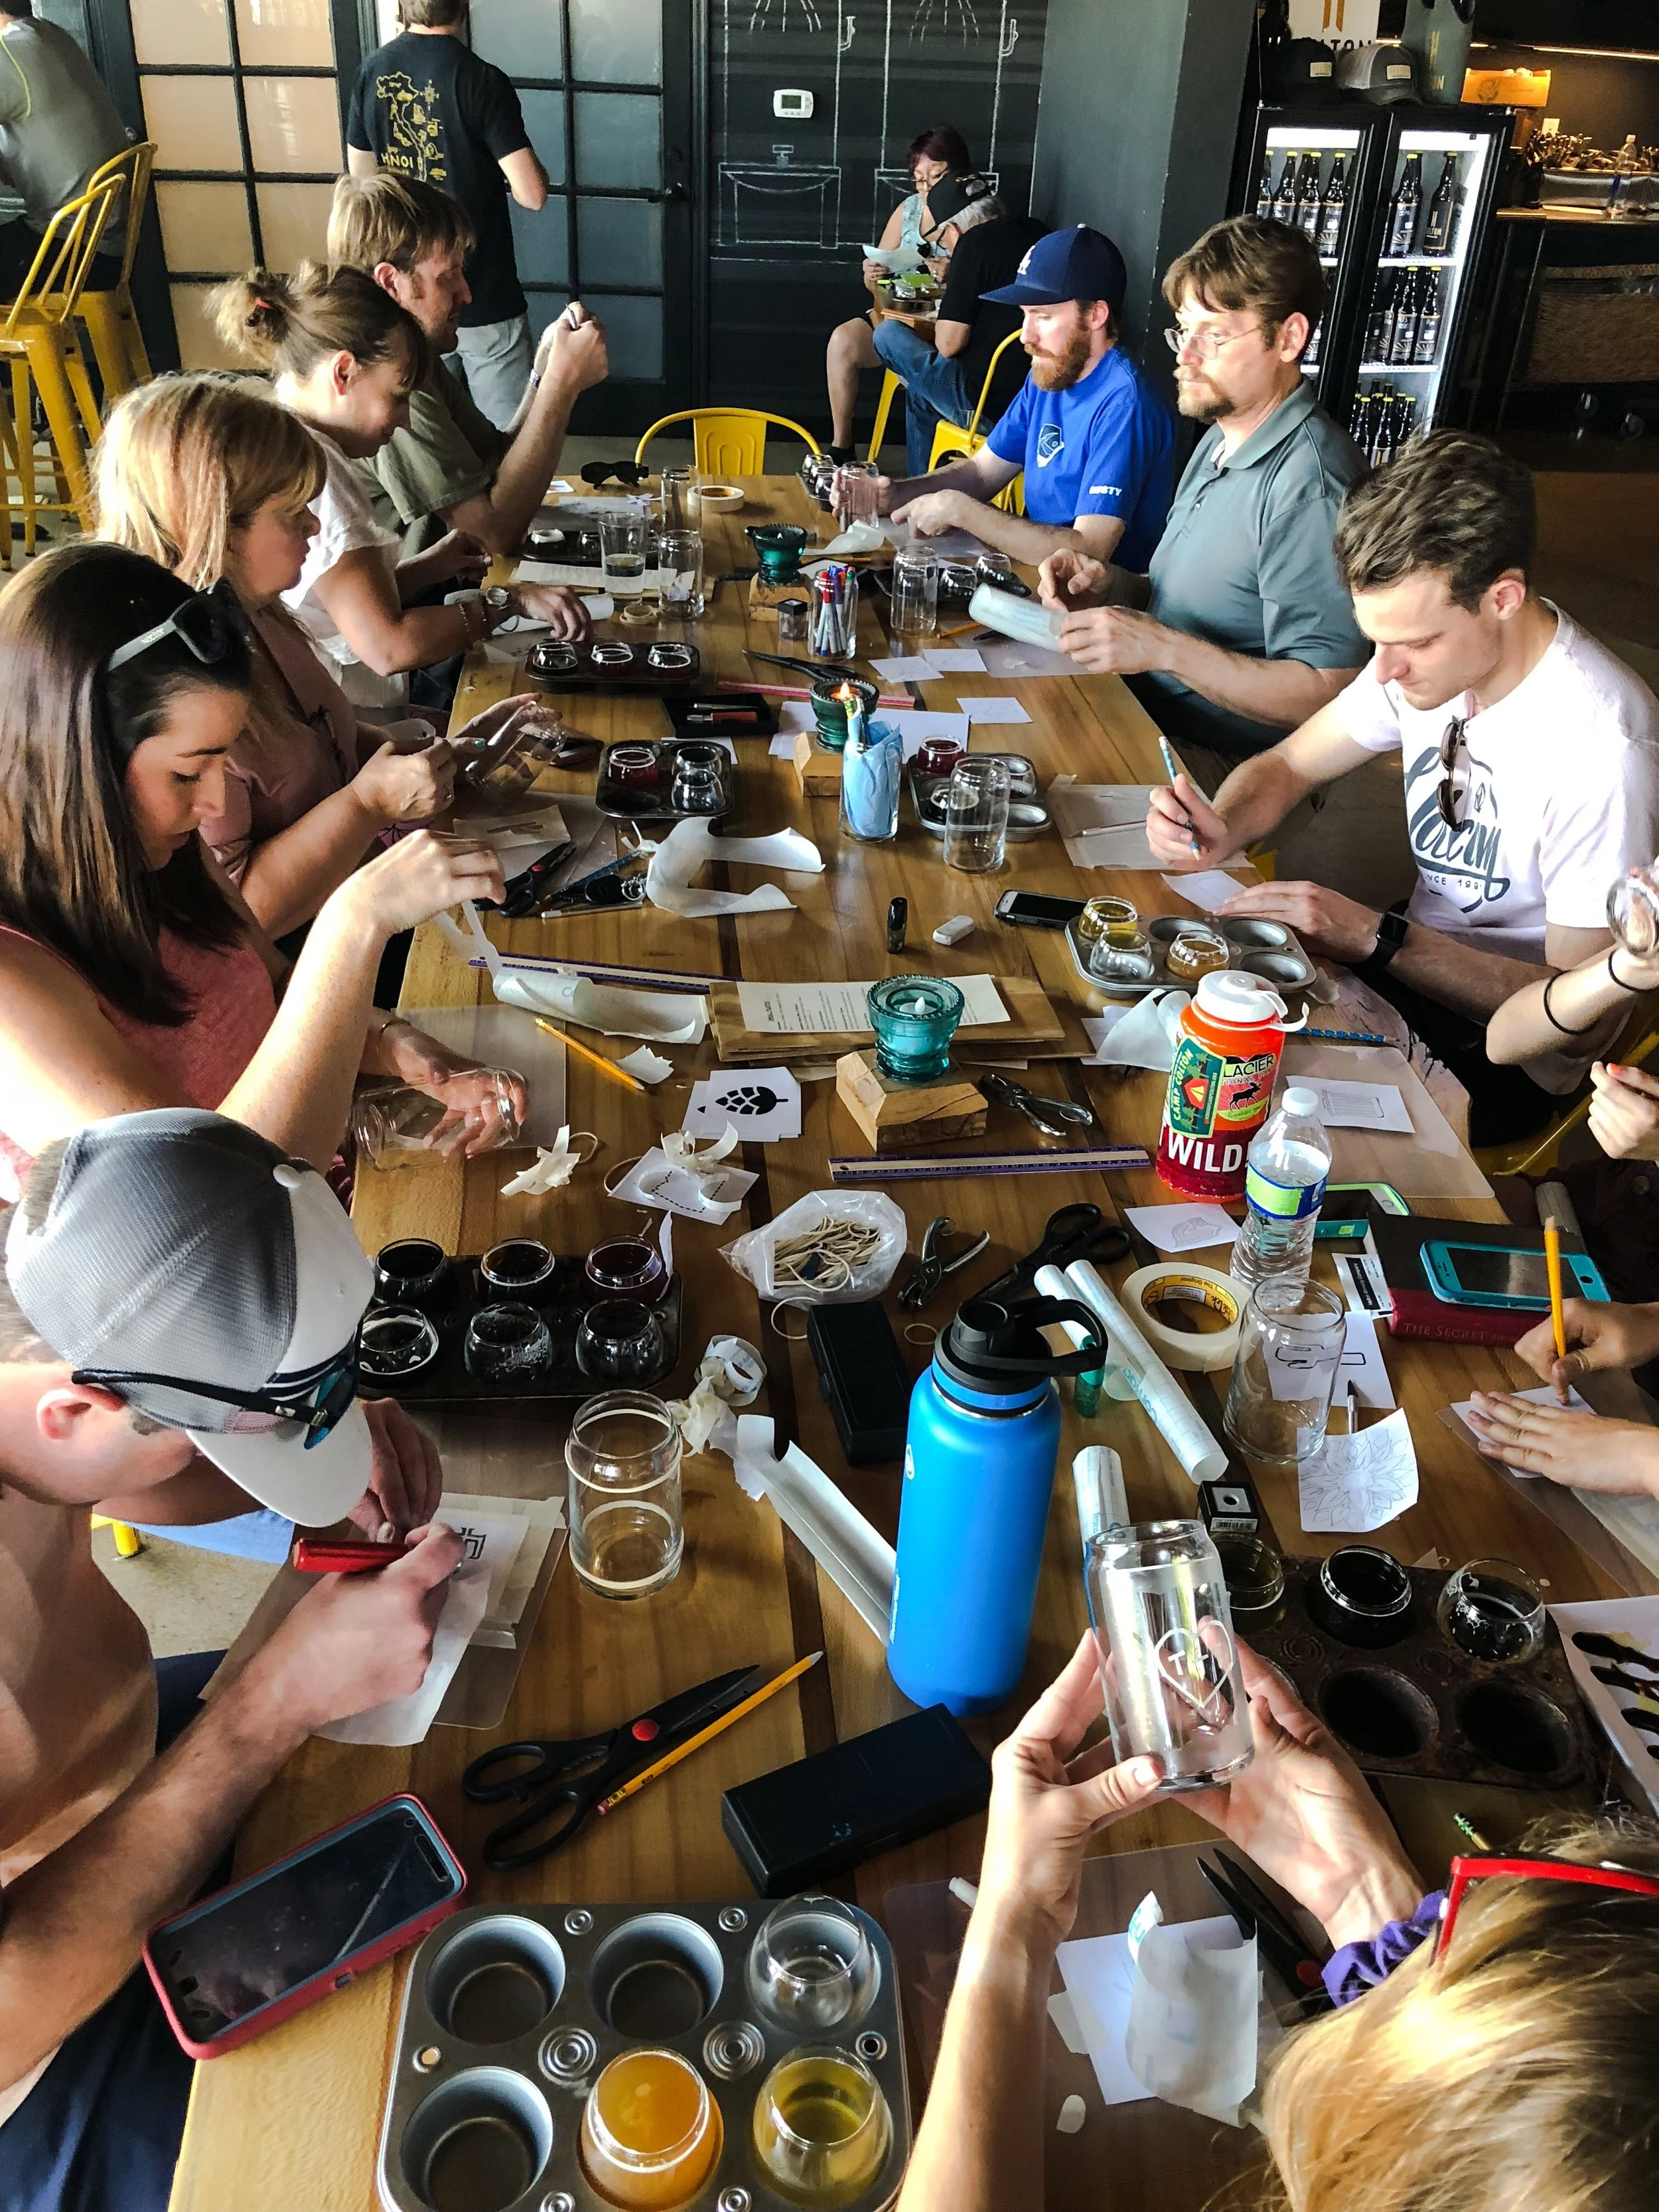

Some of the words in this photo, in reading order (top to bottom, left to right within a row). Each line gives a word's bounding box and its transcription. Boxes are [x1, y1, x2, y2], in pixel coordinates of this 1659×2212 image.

[1458, 875, 1483, 890] 199
[1175, 1048, 1195, 1086] COLTON
[1222, 1054, 1275, 1079] LACIER
[1172, 1087, 1183, 1122] CAMP
[1180, 1276, 1202, 1286] Original
[1203, 1280, 1213, 1290] The
[1403, 1323, 1431, 1336] THE
[1435, 1326, 1488, 1341] SECRET
